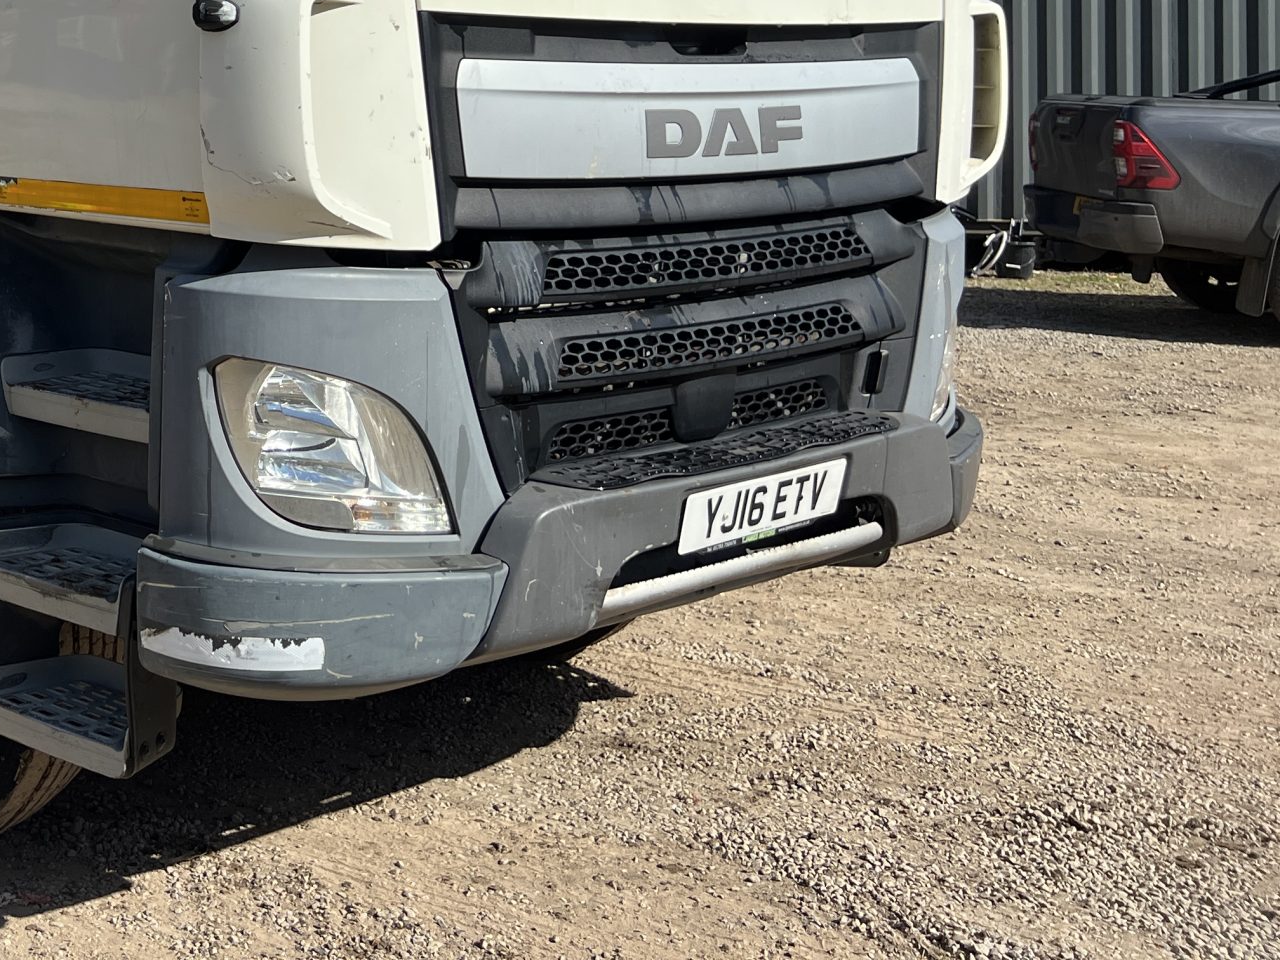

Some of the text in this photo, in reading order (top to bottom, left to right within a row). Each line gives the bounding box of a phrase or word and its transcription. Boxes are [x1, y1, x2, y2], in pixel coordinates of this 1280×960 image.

[645, 105, 803, 158] DAF
[706, 470, 828, 539] YJ16 ETV
